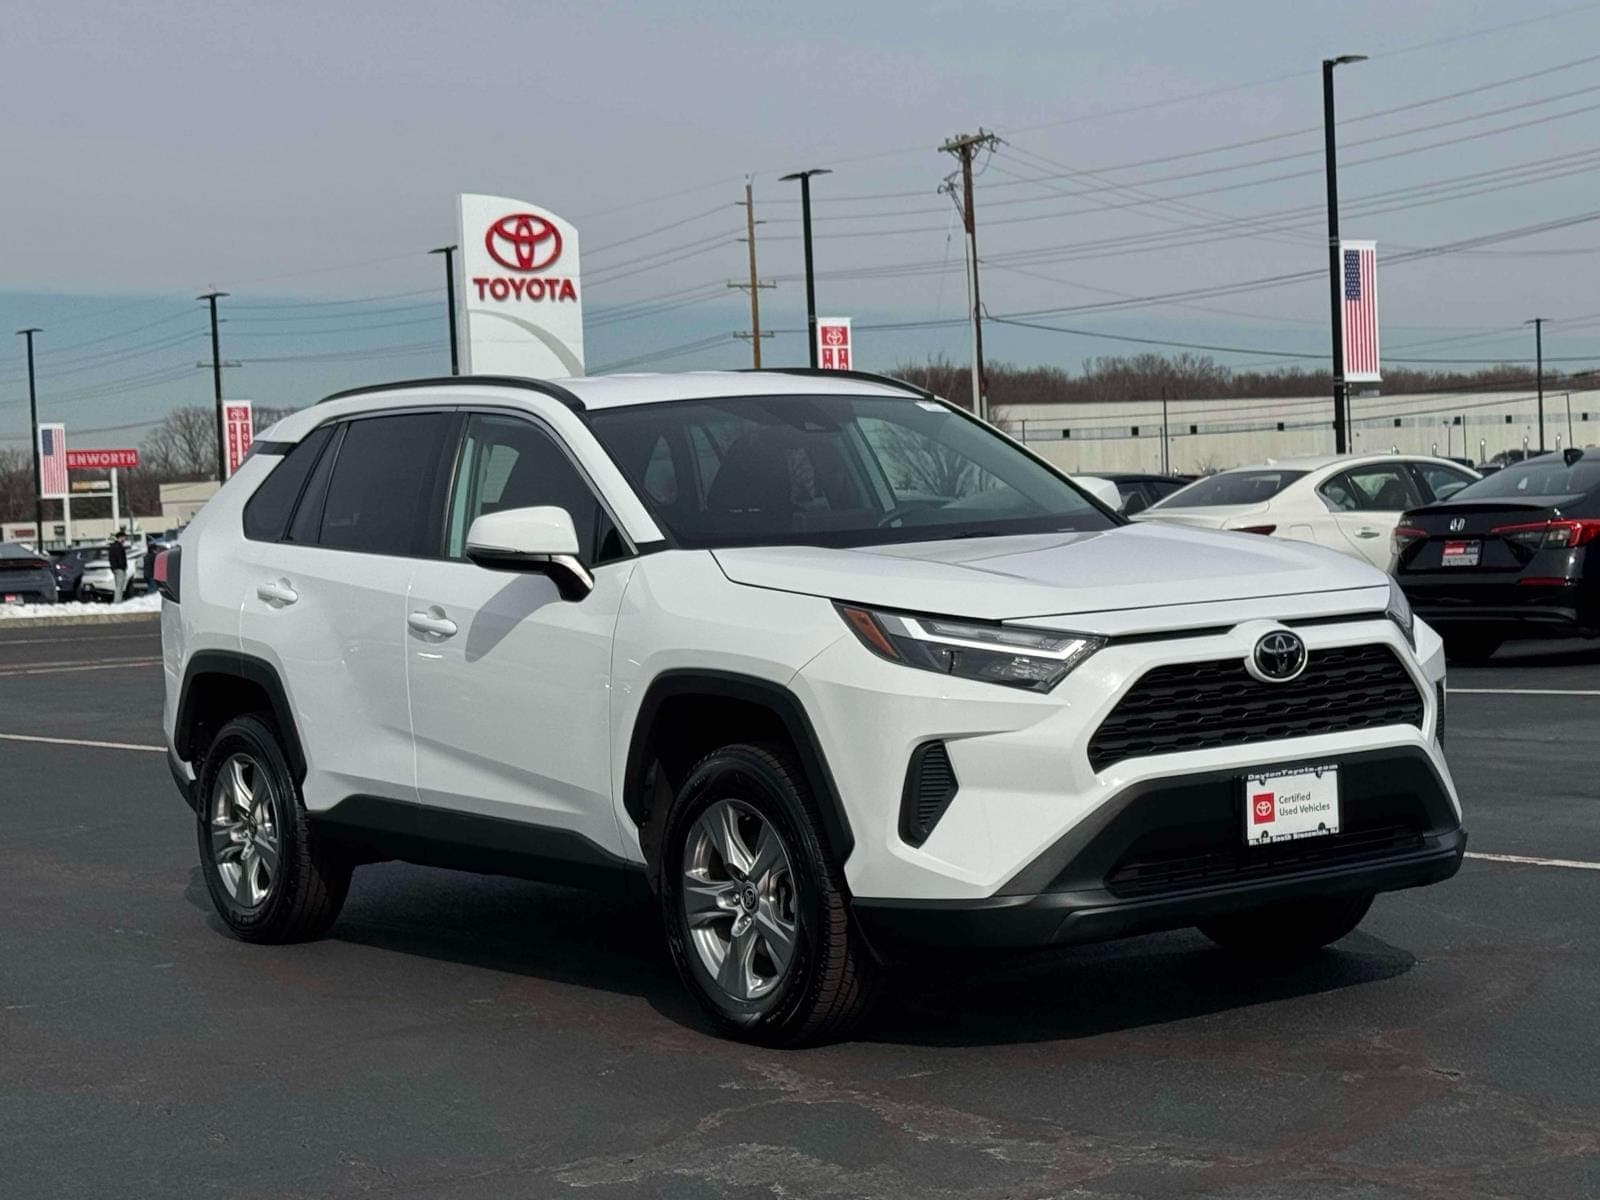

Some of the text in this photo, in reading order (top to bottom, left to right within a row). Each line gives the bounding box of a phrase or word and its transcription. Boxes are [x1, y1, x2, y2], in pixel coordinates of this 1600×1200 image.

[473, 277, 577, 302] TOYOTA
[68, 453, 136, 465] ENWORTH
[1279, 792, 1311, 804] Certified
[1279, 803, 1330, 816] Used Vehicles
